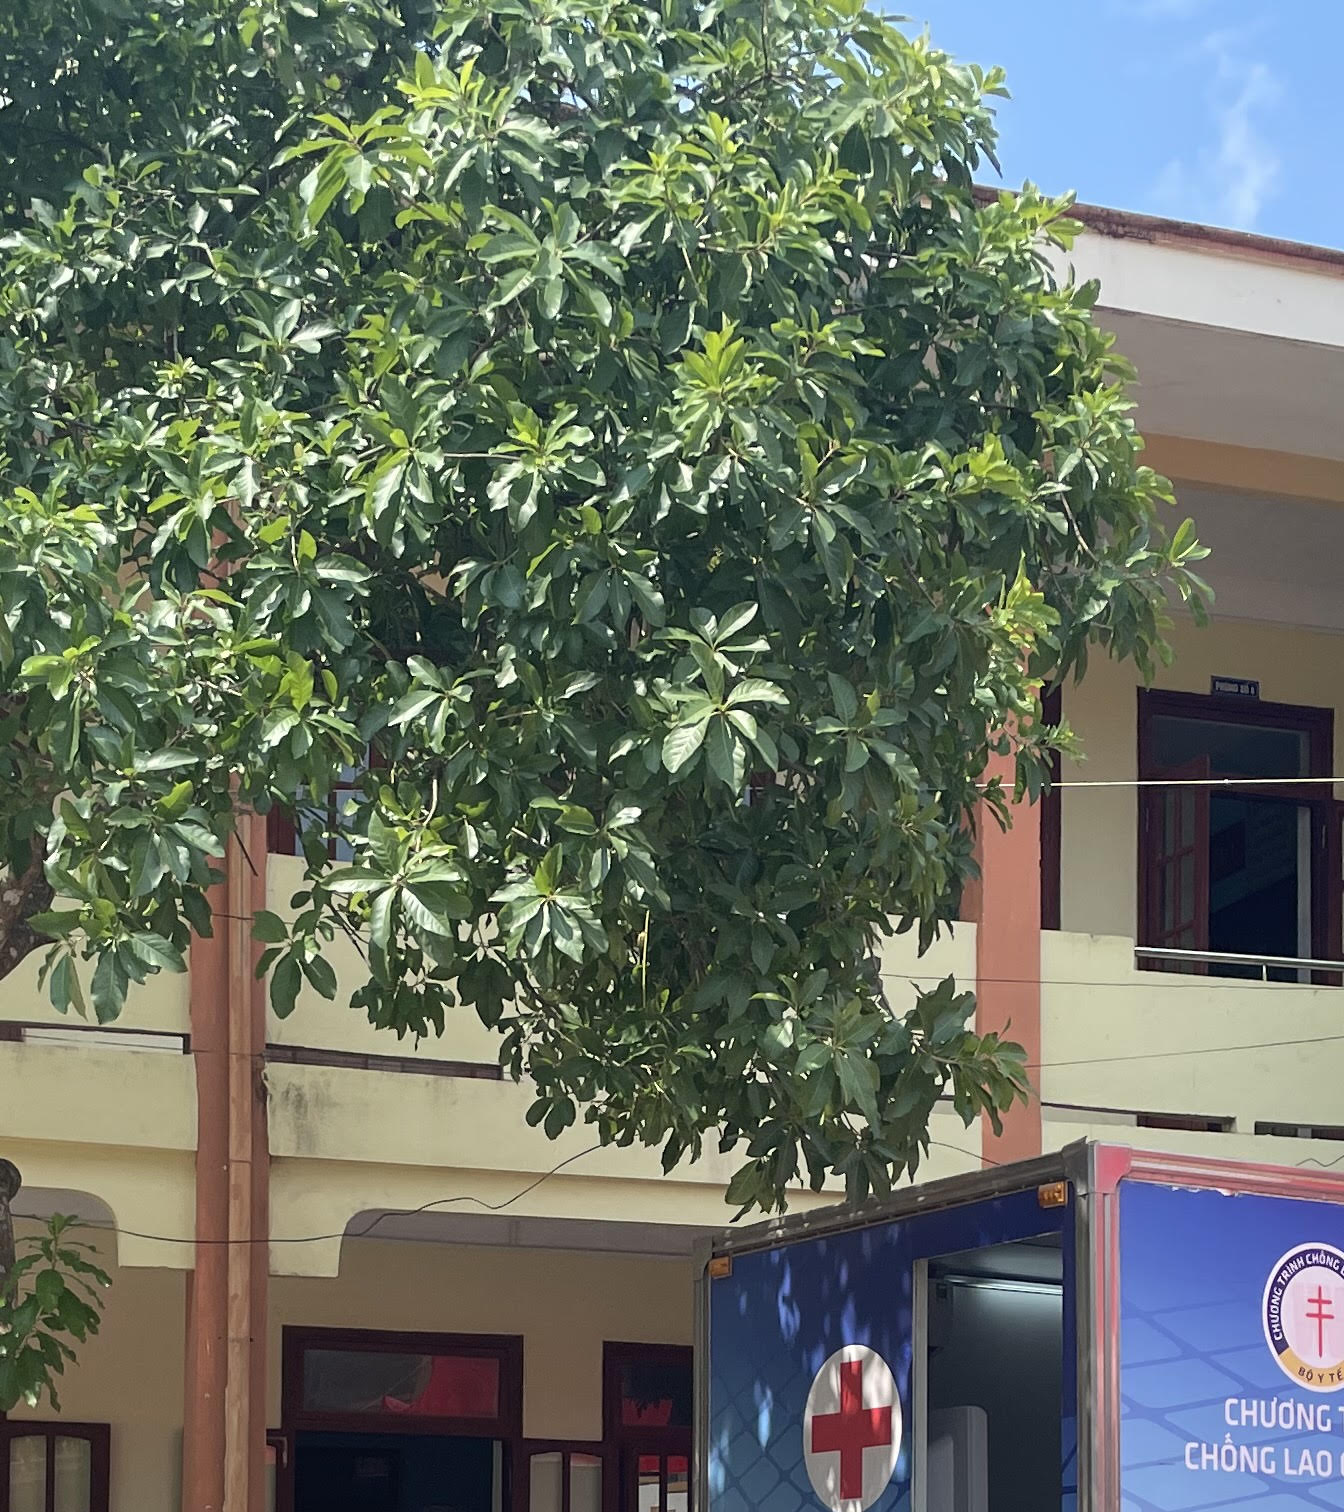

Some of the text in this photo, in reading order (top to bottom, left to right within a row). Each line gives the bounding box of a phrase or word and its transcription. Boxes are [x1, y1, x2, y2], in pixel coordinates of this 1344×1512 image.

[1269, 1287, 1283, 1341] CHƯƠNG
[1277, 1257, 1305, 1286] TRÌNH
[1306, 1250, 1341, 1271] CHỐNG
[1298, 1366, 1344, 1384] BỘ Y TẾ
[1224, 1396, 1332, 1433] CHƯƠNG
[1184, 1432, 1276, 1475] CHỐNG
[1283, 1447, 1333, 1478] LAO
